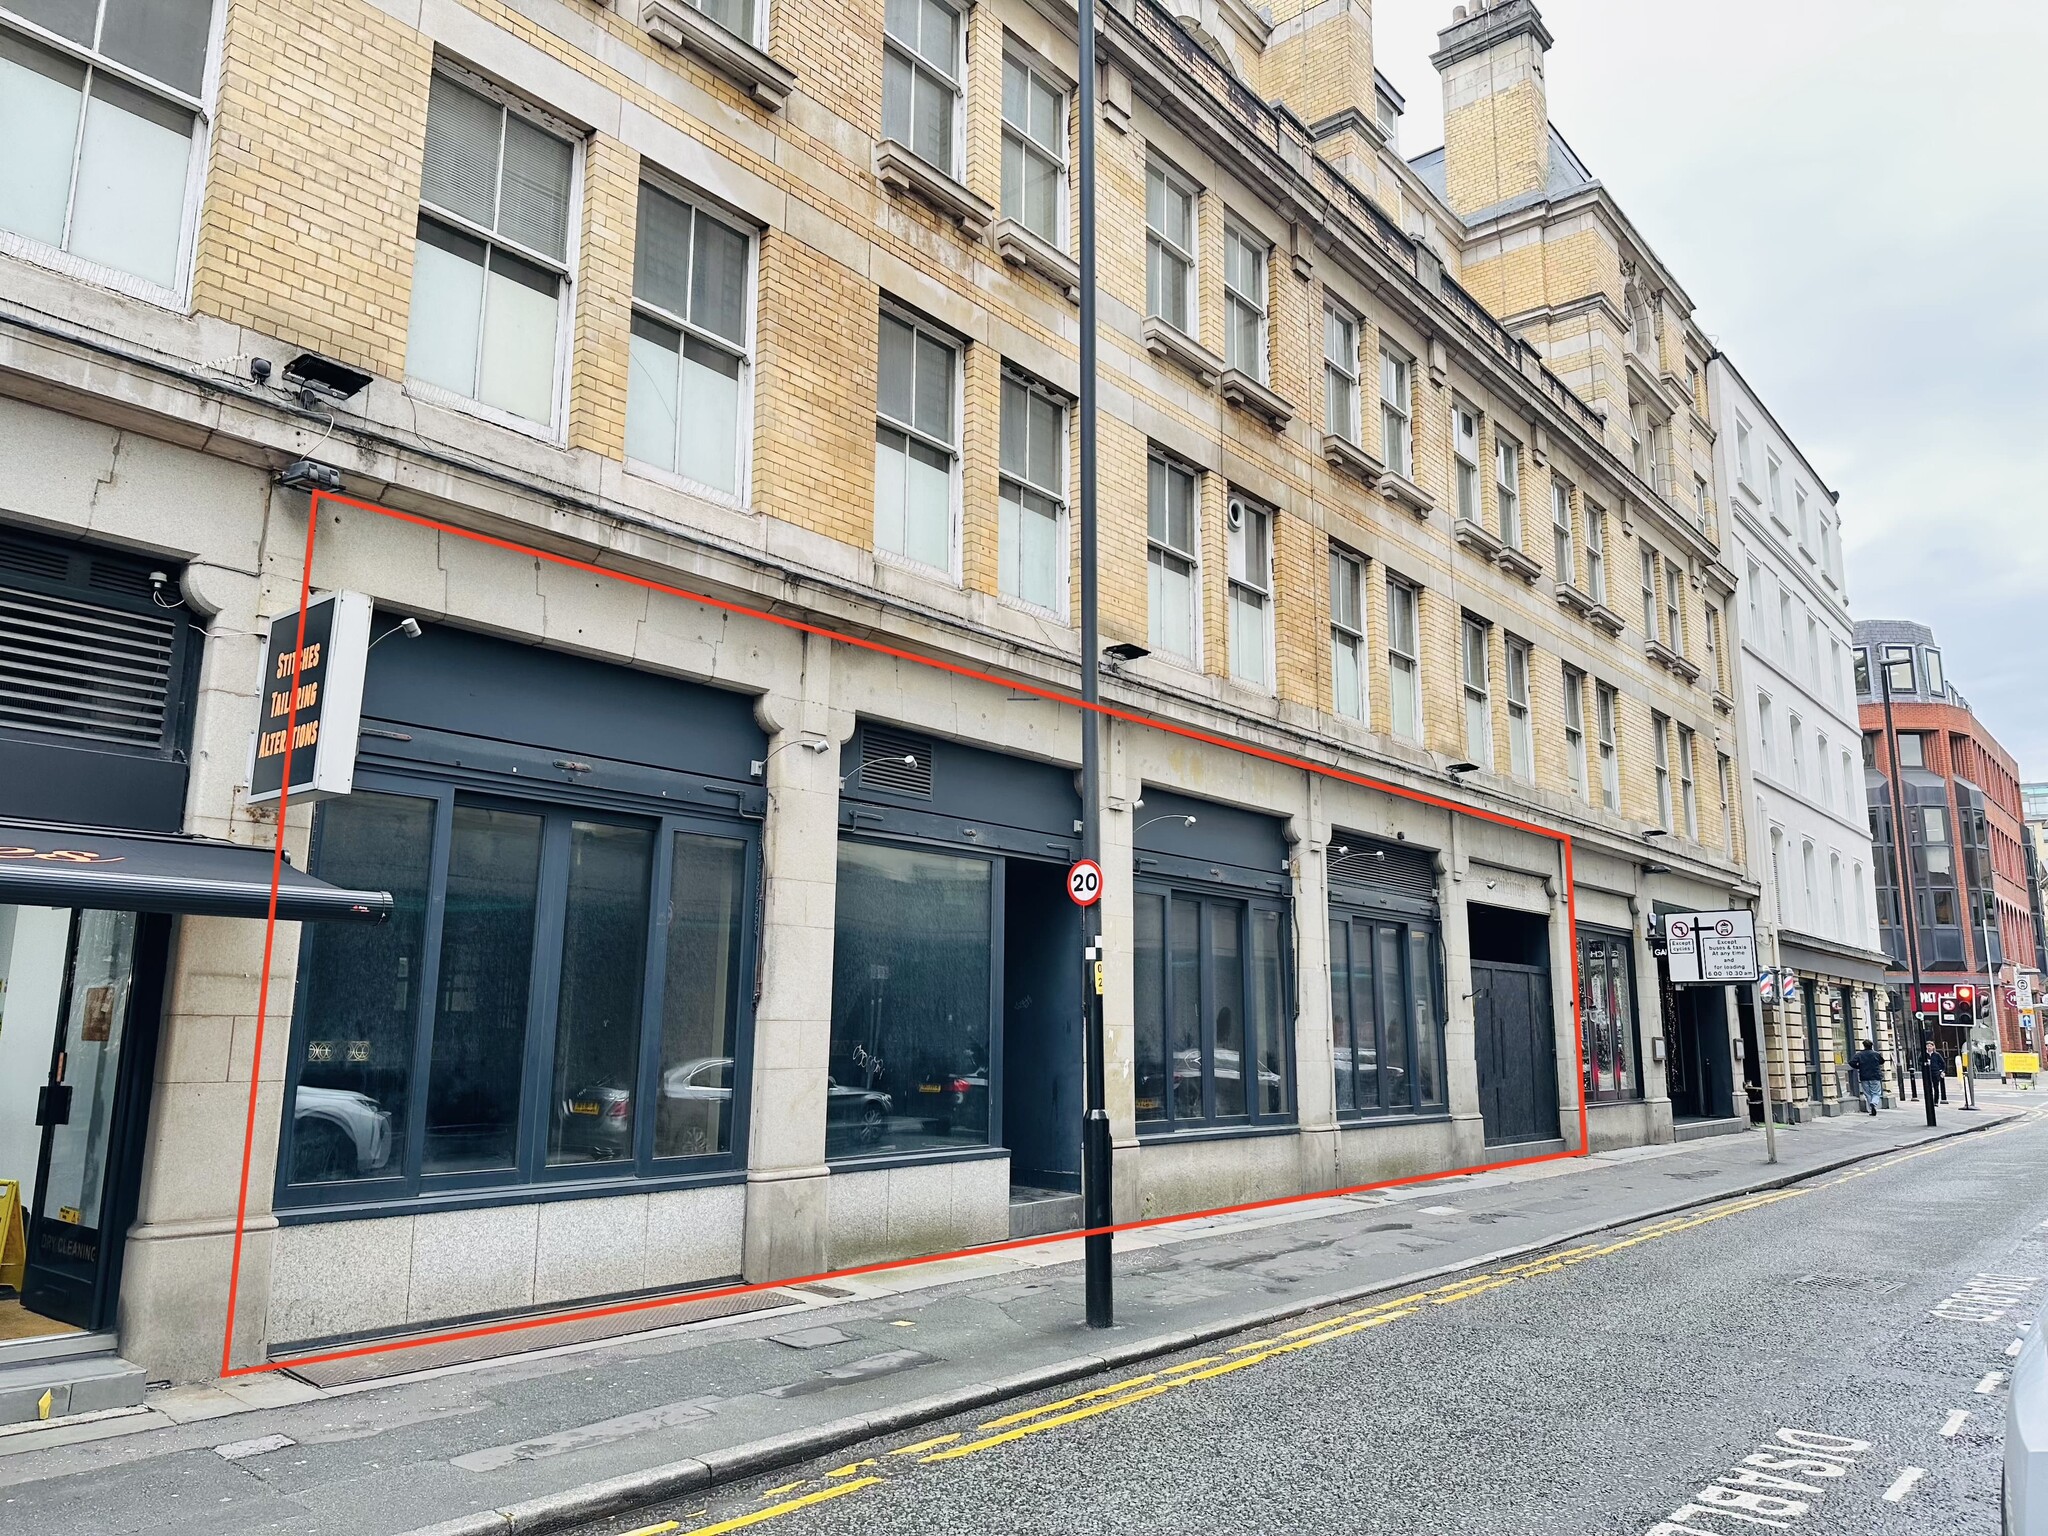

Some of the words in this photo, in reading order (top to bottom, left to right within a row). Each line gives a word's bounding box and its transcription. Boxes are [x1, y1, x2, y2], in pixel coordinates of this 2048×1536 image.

[258, 719, 319, 759] ALTERTIONS
[1073, 873, 1097, 892] 20
[41, 1234, 57, 1252] DRY
[57, 1237, 97, 1262] CLEANING
